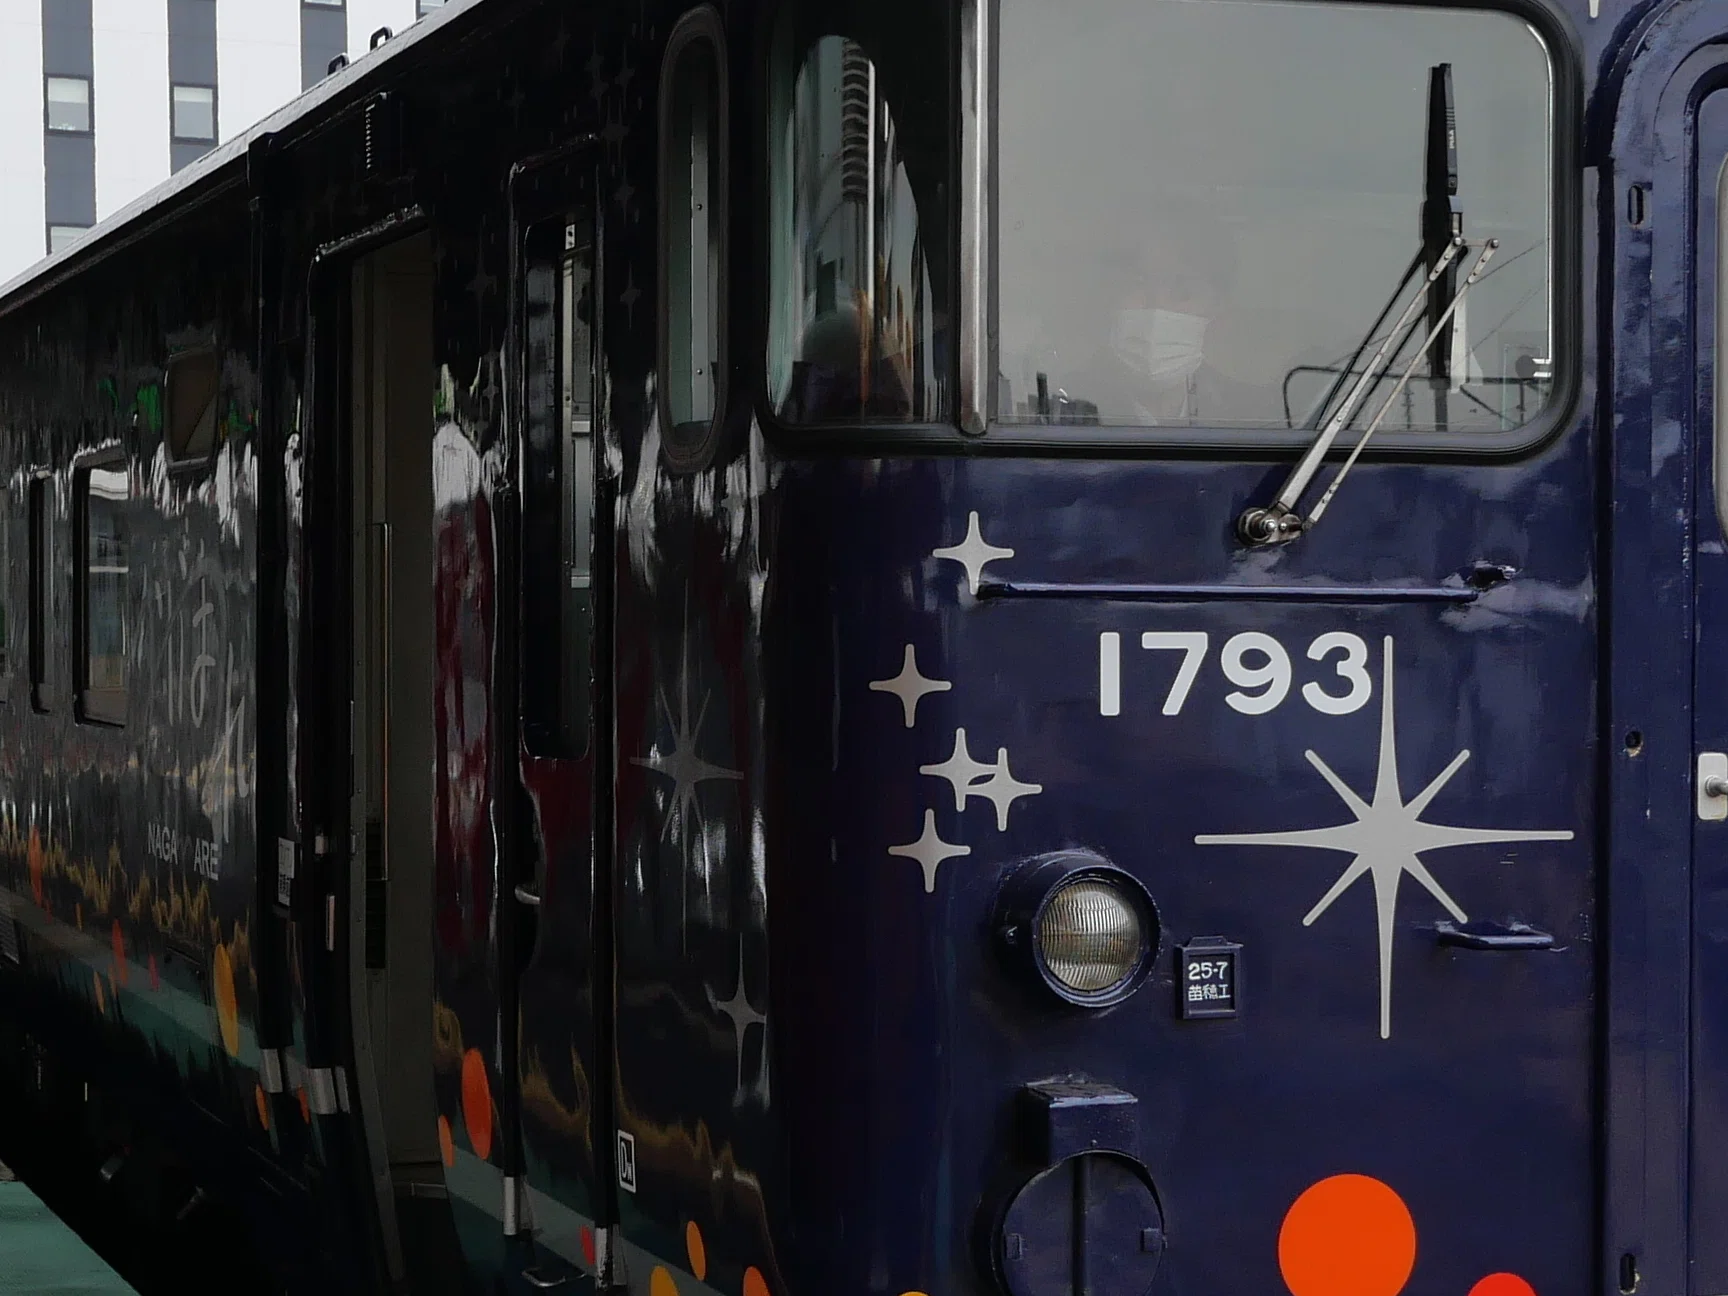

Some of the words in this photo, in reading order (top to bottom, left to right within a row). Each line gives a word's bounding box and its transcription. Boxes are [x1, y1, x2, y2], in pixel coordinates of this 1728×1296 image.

[1101, 632, 1372, 715] 1793
[148, 820, 219, 882] NAGAARE
[1188, 961, 1228, 980] 25-7
